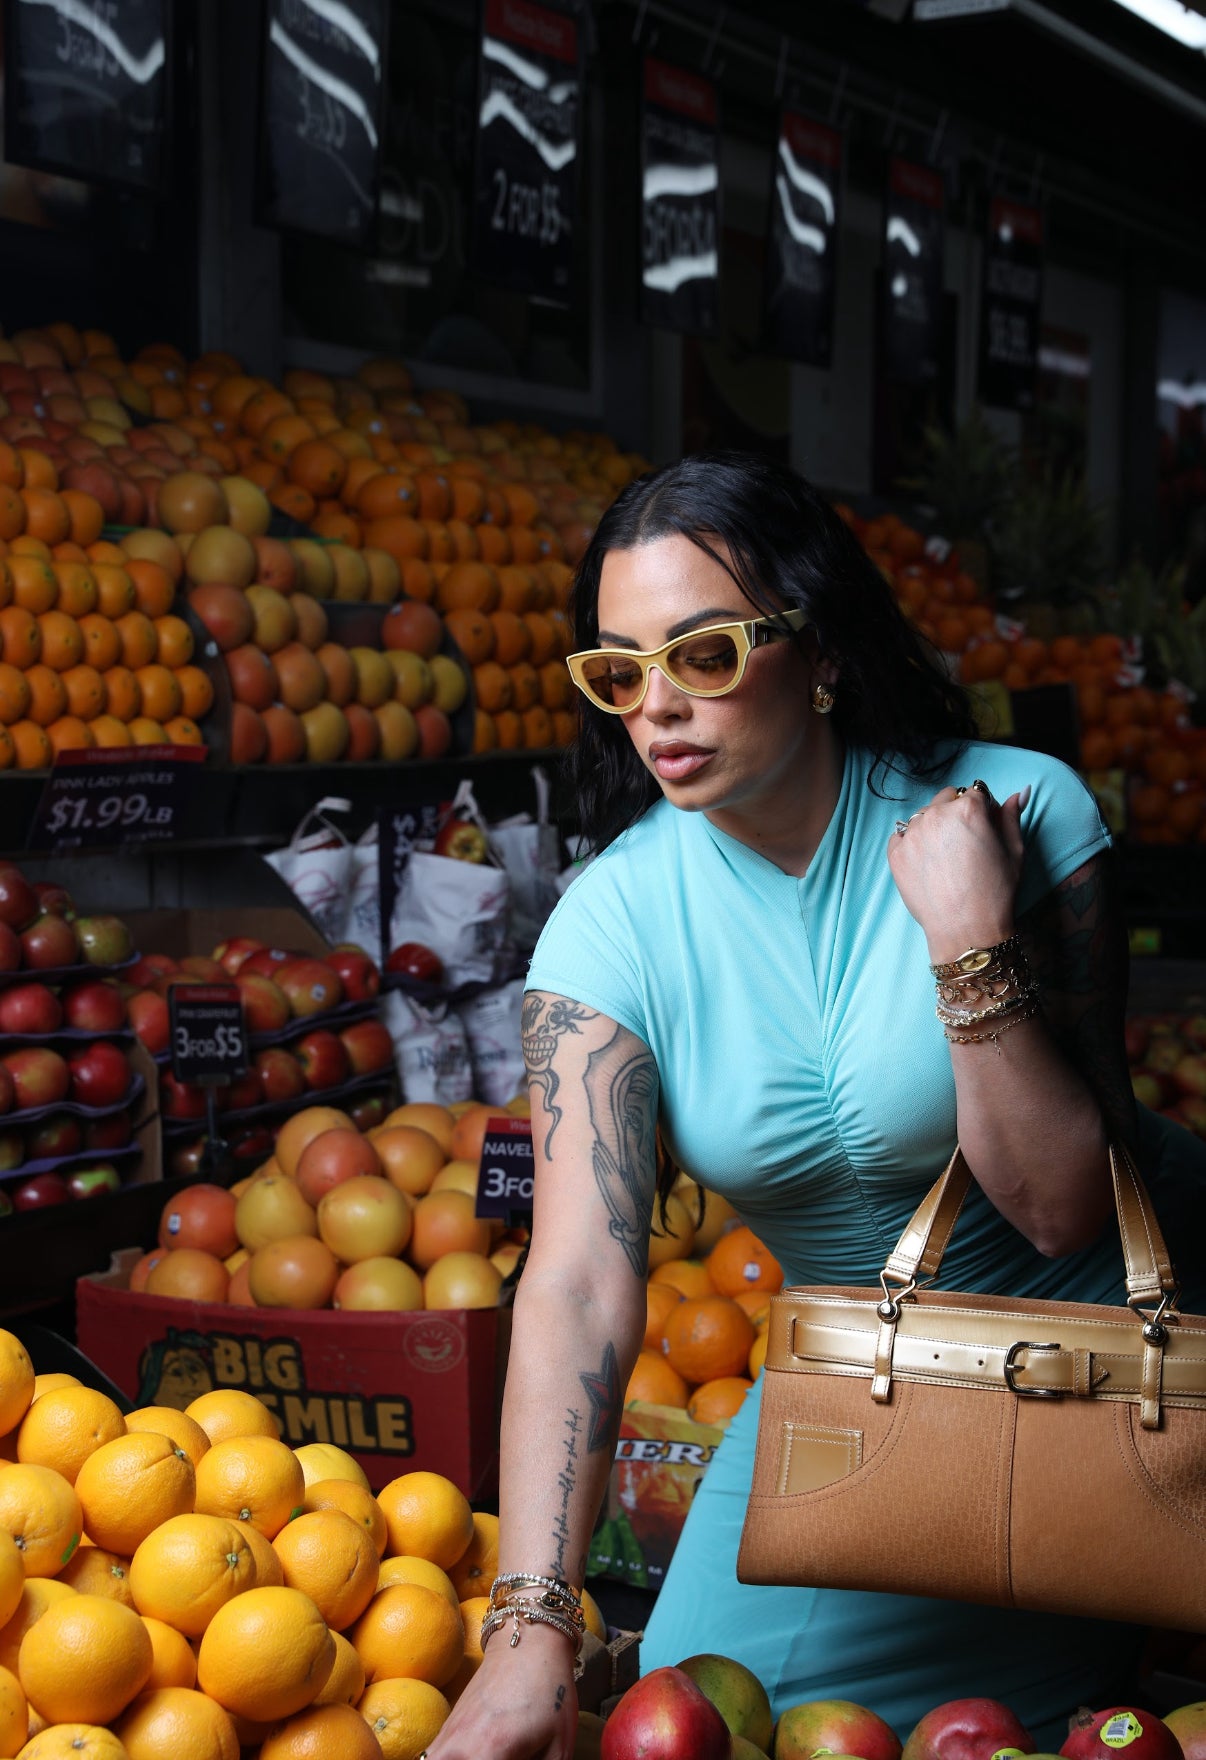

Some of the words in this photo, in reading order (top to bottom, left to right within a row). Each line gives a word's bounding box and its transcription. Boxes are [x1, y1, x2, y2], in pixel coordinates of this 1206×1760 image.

[53, 775, 86, 790] PINK
[87, 774, 124, 789] LADY
[125, 771, 176, 785] APPLES
[483, 1141, 534, 1157] NAVEL
[211, 1336, 301, 1390] BIG
